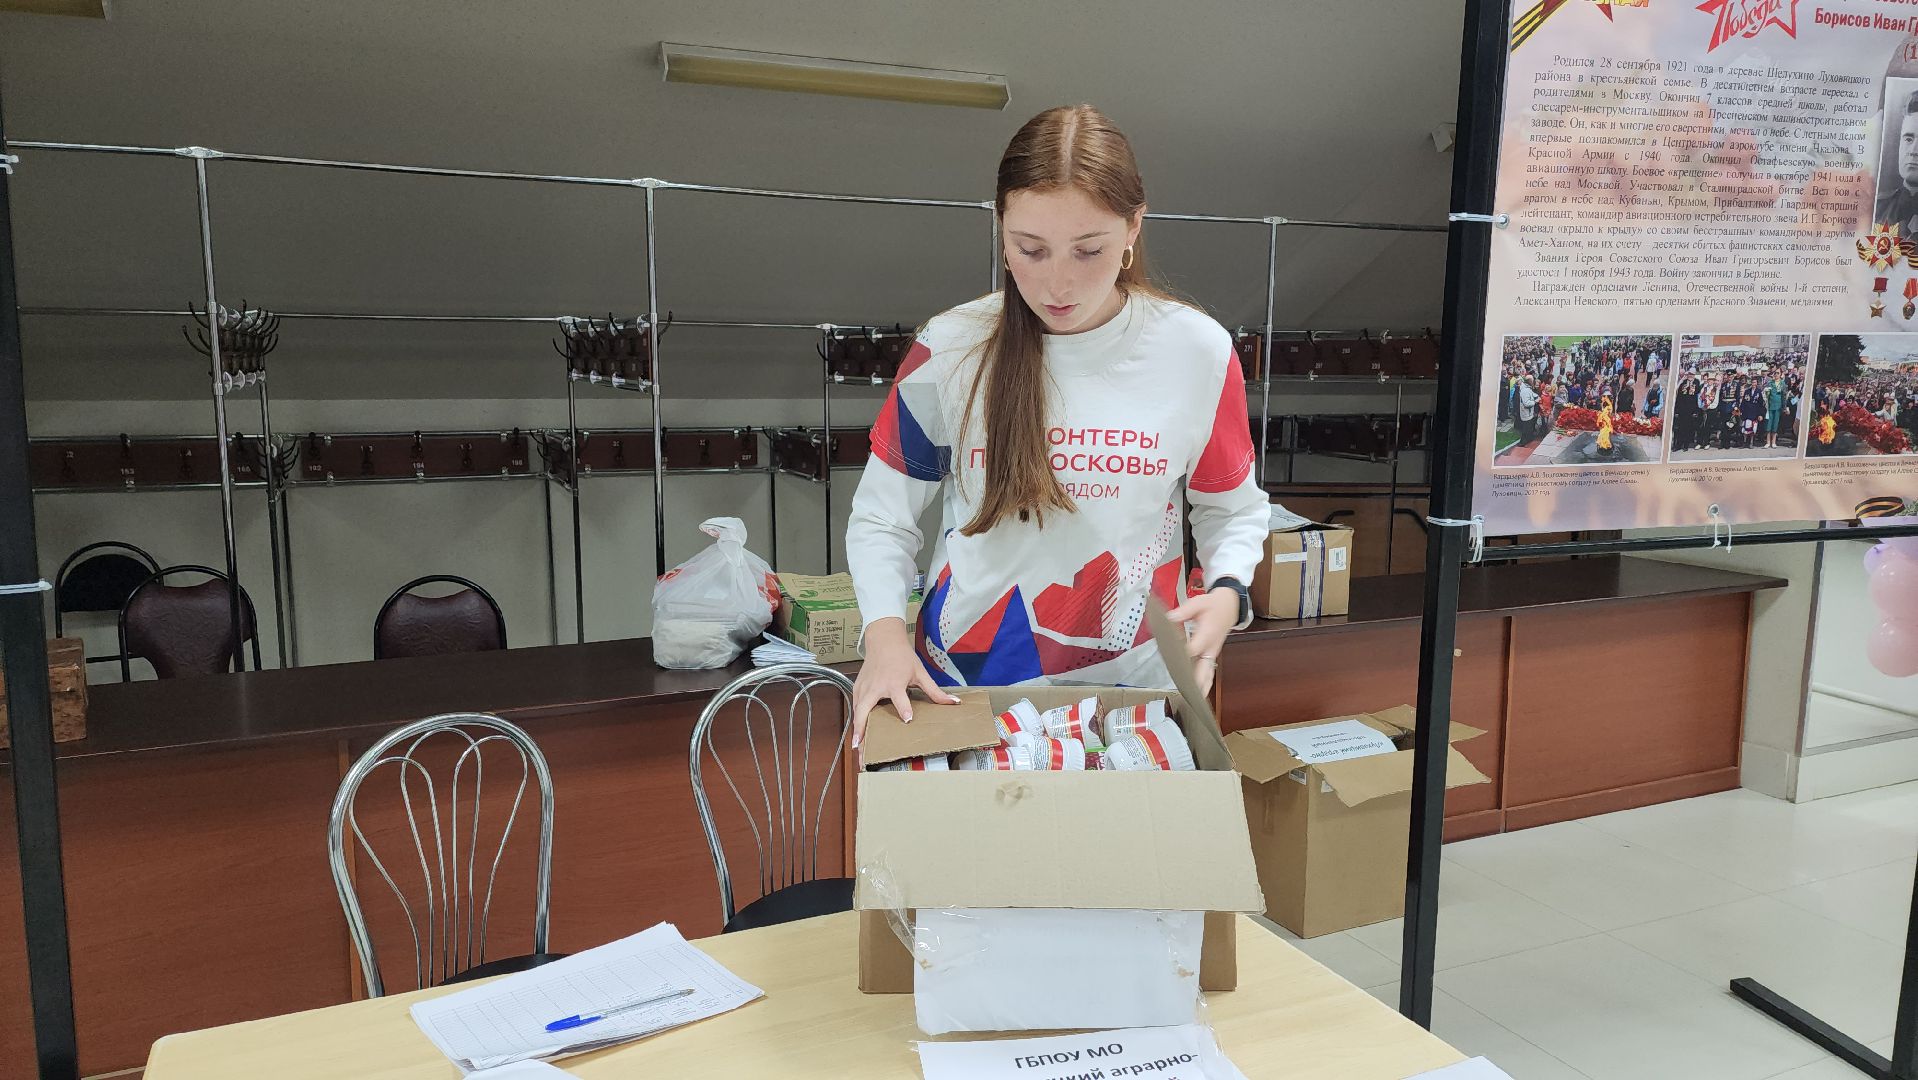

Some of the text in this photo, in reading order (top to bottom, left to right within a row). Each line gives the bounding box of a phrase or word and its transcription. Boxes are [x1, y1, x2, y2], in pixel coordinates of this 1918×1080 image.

[1815, 7, 1918, 37] Борисов Иван Гр
[1903, 43, 1918, 63] (1
[1554, 55, 1594, 68] Родился
[1617, 57, 1660, 71] сентября
[1667, 61, 1687, 71] 1921
[1694, 65, 1713, 74] года
[1535, 70, 1571, 82] района
[1591, 74, 1656, 86] крестьянской
[1533, 88, 1594, 98] родителями
[1659, 91, 1700, 103] Окончил
[1758, 99, 1792, 109] средней
[1834, 103, 1868, 114] работал
[1531, 119, 1566, 129] заводе.
[1570, 117, 1587, 129] Он,
[1656, 124, 1670, 133] его
[1770, 128, 1790, 137] небе.
[1804, 131, 1836, 140] летным
[1838, 132, 1866, 141] делом
[1663, 137, 1729, 149] Центральном
[1528, 147, 1572, 159] Красной
[1582, 149, 1615, 160] Армии
[1640, 151, 1661, 161] 1940
[1703, 153, 1741, 164] Окончил
[1527, 165, 1594, 175] авиационную
[1633, 166, 1664, 176] Боевое
[1774, 171, 1809, 184] октябре
[1813, 172, 1831, 181] 1941
[1526, 178, 1548, 188] небе
[1554, 180, 1571, 189] над
[1578, 179, 1623, 190] Москвой.
[1630, 180, 1683, 192] Участвовал
[1524, 195, 1557, 205] врагом
[1598, 197, 1614, 205] над
[1668, 196, 1709, 208] Крымом,
[1714, 197, 1776, 208] Прибалтикой.
[1820, 202, 1858, 211] старший
[1577, 209, 1623, 221] командир
[1695, 210, 1771, 223] истребительного
[1822, 215, 1857, 225] Борисов
[1520, 223, 1553, 233] воевал
[1558, 224, 1594, 235] «крыло
[1607, 225, 1642, 236] крылу»
[1759, 228, 1813, 239] командиром
[1652, 241, 1689, 250] десятки
[1729, 239, 1787, 251] фашистских
[1786, 242, 1832, 251] самолетов.
[1535, 252, 1569, 262] Звания
[1609, 253, 1662, 264] Советского
[1669, 254, 1698, 264] Союза
[1705, 254, 1727, 264] Иван
[1795, 256, 1830, 266] Борисов
[1836, 257, 1852, 265] был
[1572, 268, 1605, 279] ноября
[1609, 267, 1630, 277] 1943
[1634, 269, 1656, 277] года.
[1659, 268, 1689, 280] Войну
[1693, 269, 1732, 278] закончил
[1687, 282, 1754, 293] Отечественной
[1761, 283, 1788, 293] войны
[1514, 296, 1571, 307] Александра
[1656, 297, 1699, 308] орденами
[1703, 296, 1745, 309] Красного
[1748, 296, 1787, 307] Знамени,
[1047, 427, 1160, 449] ОНТЕРЫ
[970, 447, 1168, 476] ПОСКОВЬЯ
[1014, 1043, 1123, 1069] ГБПОУ МО
[1110, 1053, 1199, 1077] аграрно-
